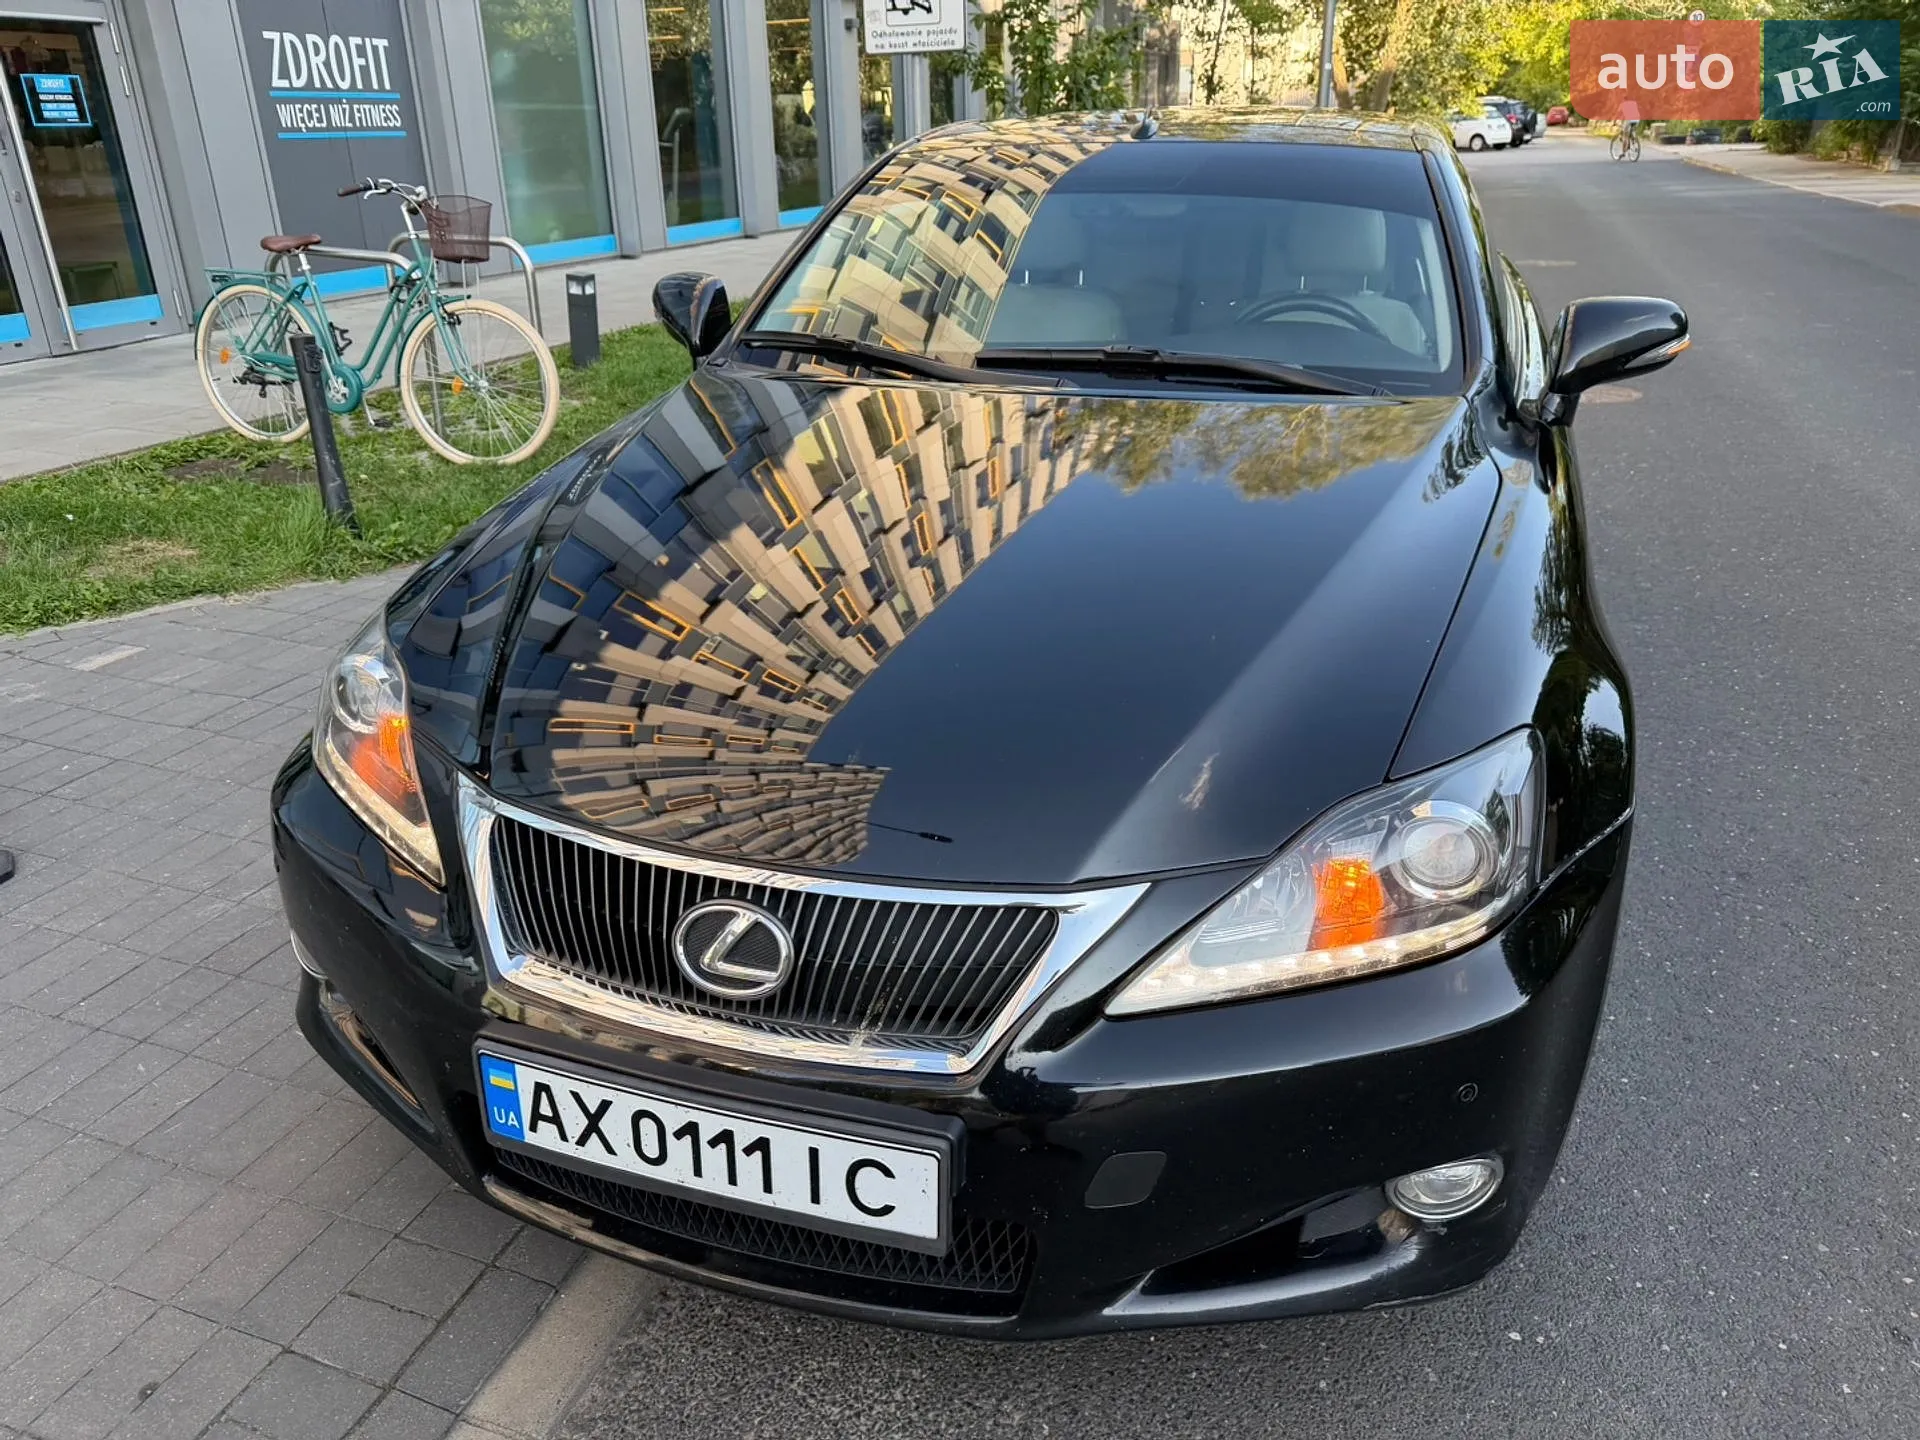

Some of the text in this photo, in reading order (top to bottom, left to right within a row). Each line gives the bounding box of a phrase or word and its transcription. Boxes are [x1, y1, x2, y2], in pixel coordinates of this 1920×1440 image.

[262, 31, 391, 90] ZDROFIT
[276, 98, 402, 133] WIĘCEJ NIŻ FITNESS
[494, 1106, 520, 1129] UA
[528, 1081, 897, 1218] AX 0111 IC
